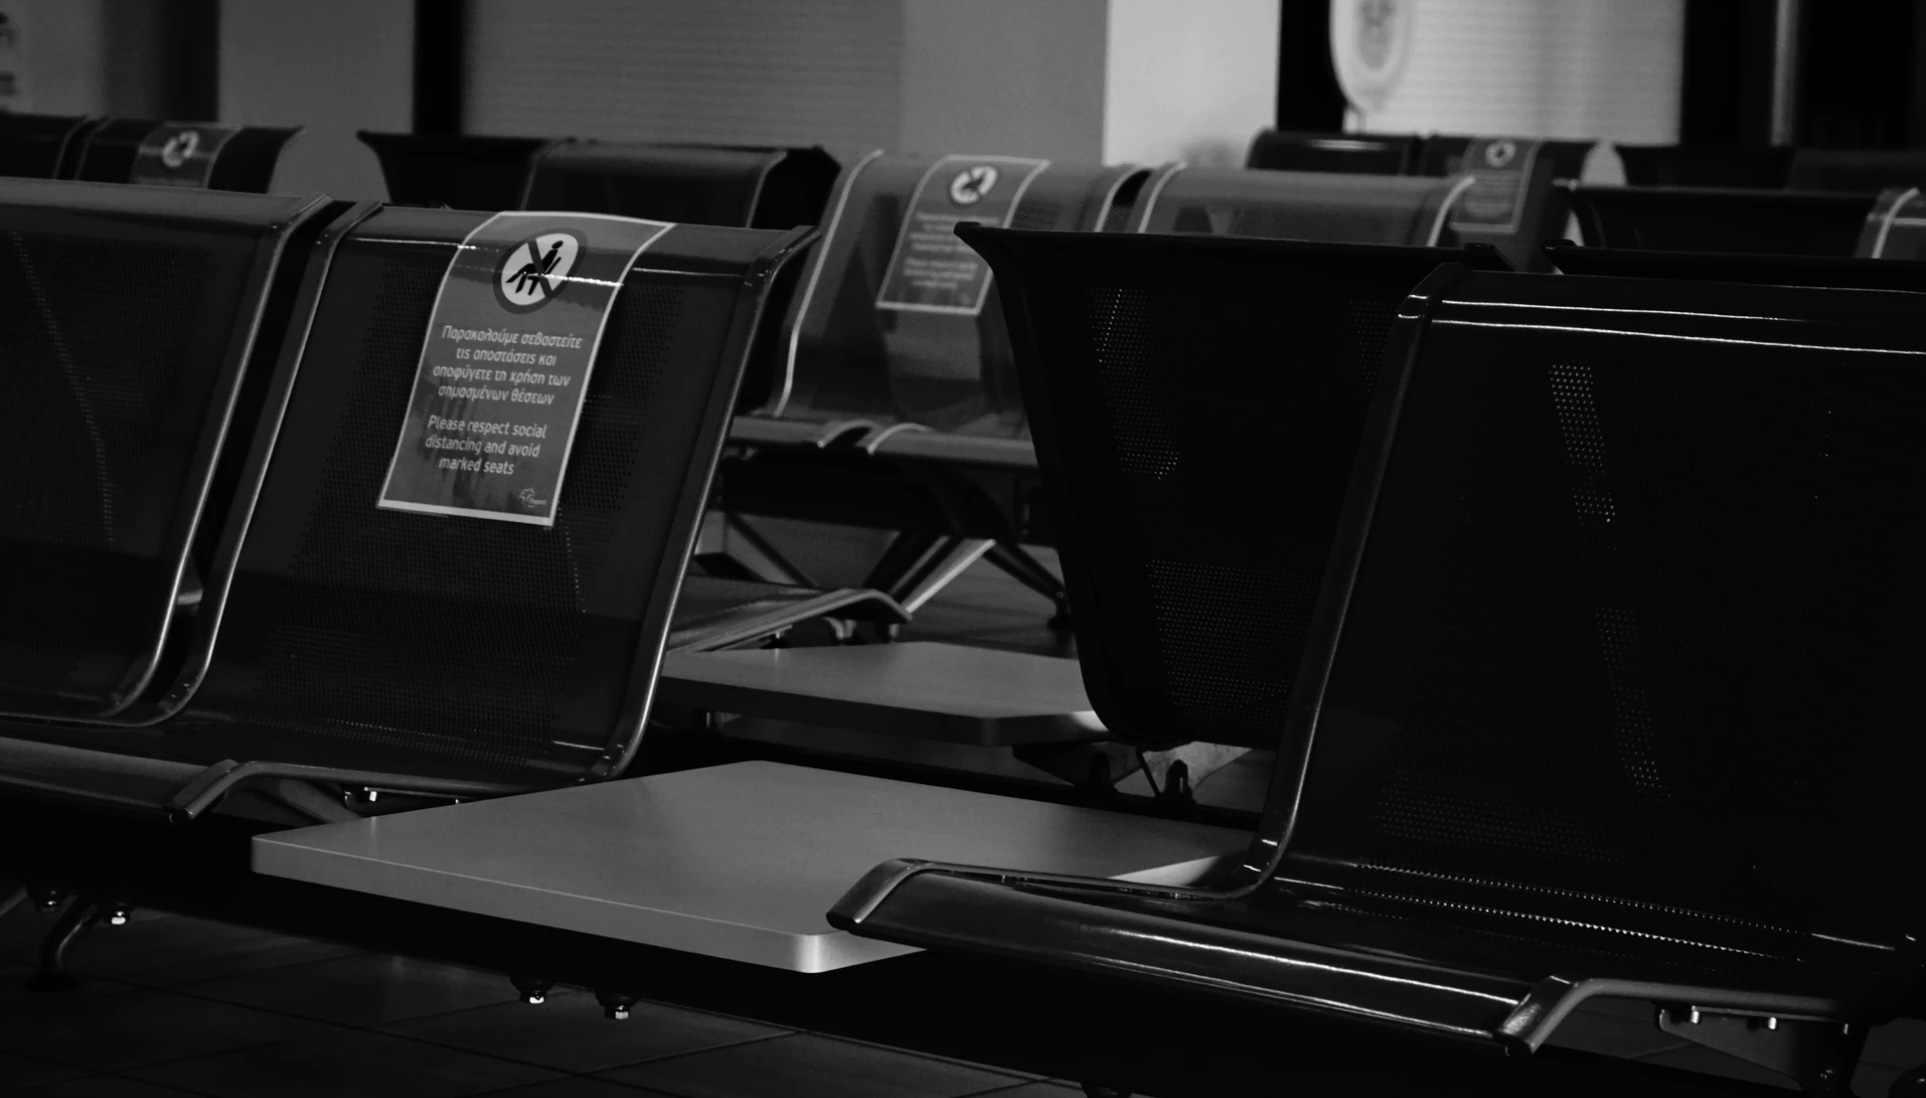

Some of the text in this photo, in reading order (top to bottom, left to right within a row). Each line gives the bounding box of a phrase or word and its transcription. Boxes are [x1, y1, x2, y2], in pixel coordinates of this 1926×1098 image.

[442, 325, 583, 349] Παρακαλούμε σεβαστείτε
[456, 348, 557, 367] τις αποστάσεις και
[433, 364, 571, 387] αποφύγετε τη χρήση των
[438, 385, 555, 405] σημασμένων θέσεων
[427, 414, 548, 439] Please respect social
[425, 434, 541, 458] distancing and avoid
[438, 456, 515, 475] marked seats
